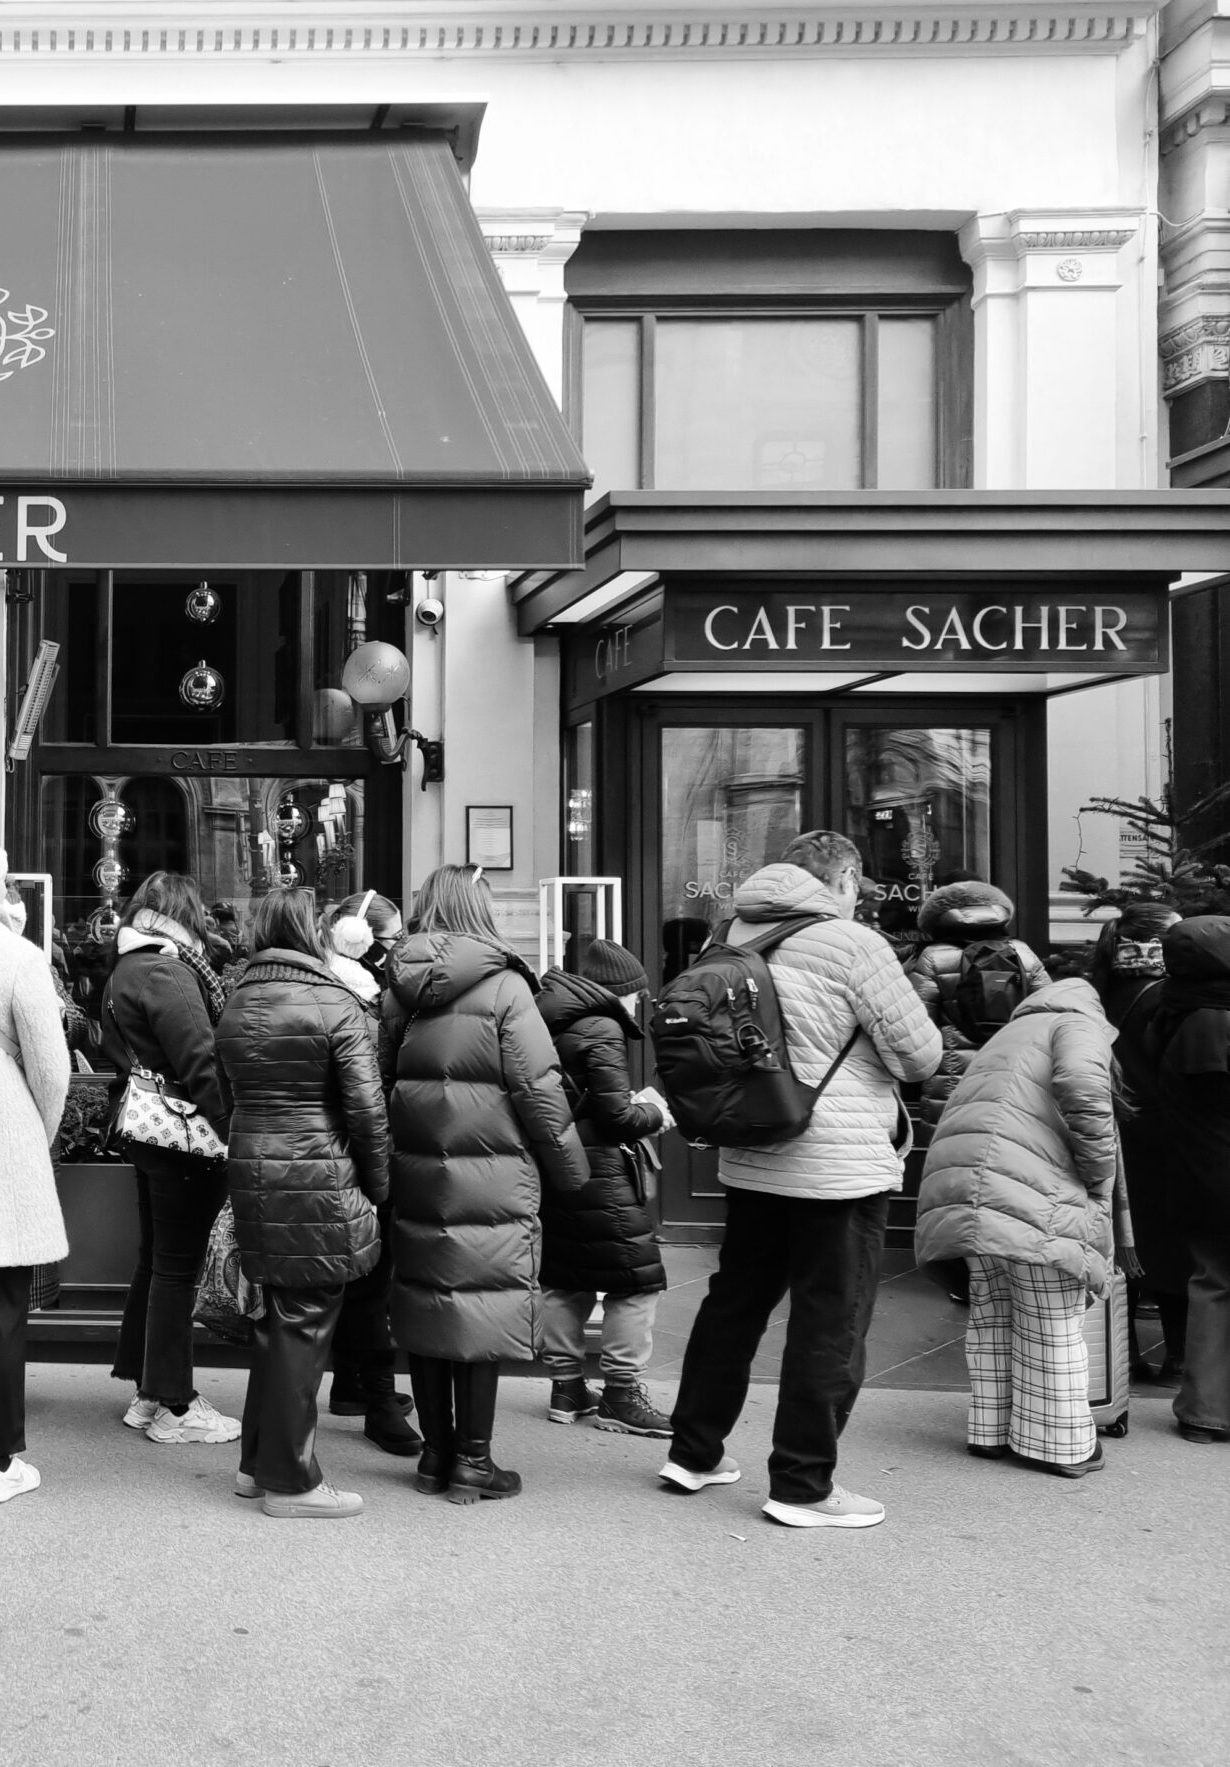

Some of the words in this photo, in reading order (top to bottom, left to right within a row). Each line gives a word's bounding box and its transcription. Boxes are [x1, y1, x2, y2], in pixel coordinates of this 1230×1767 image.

[703, 605, 852, 650] CAFE
[900, 605, 1129, 651] SACHER
[595, 623, 634, 680] CAFE
[171, 750, 238, 770] CAFE
